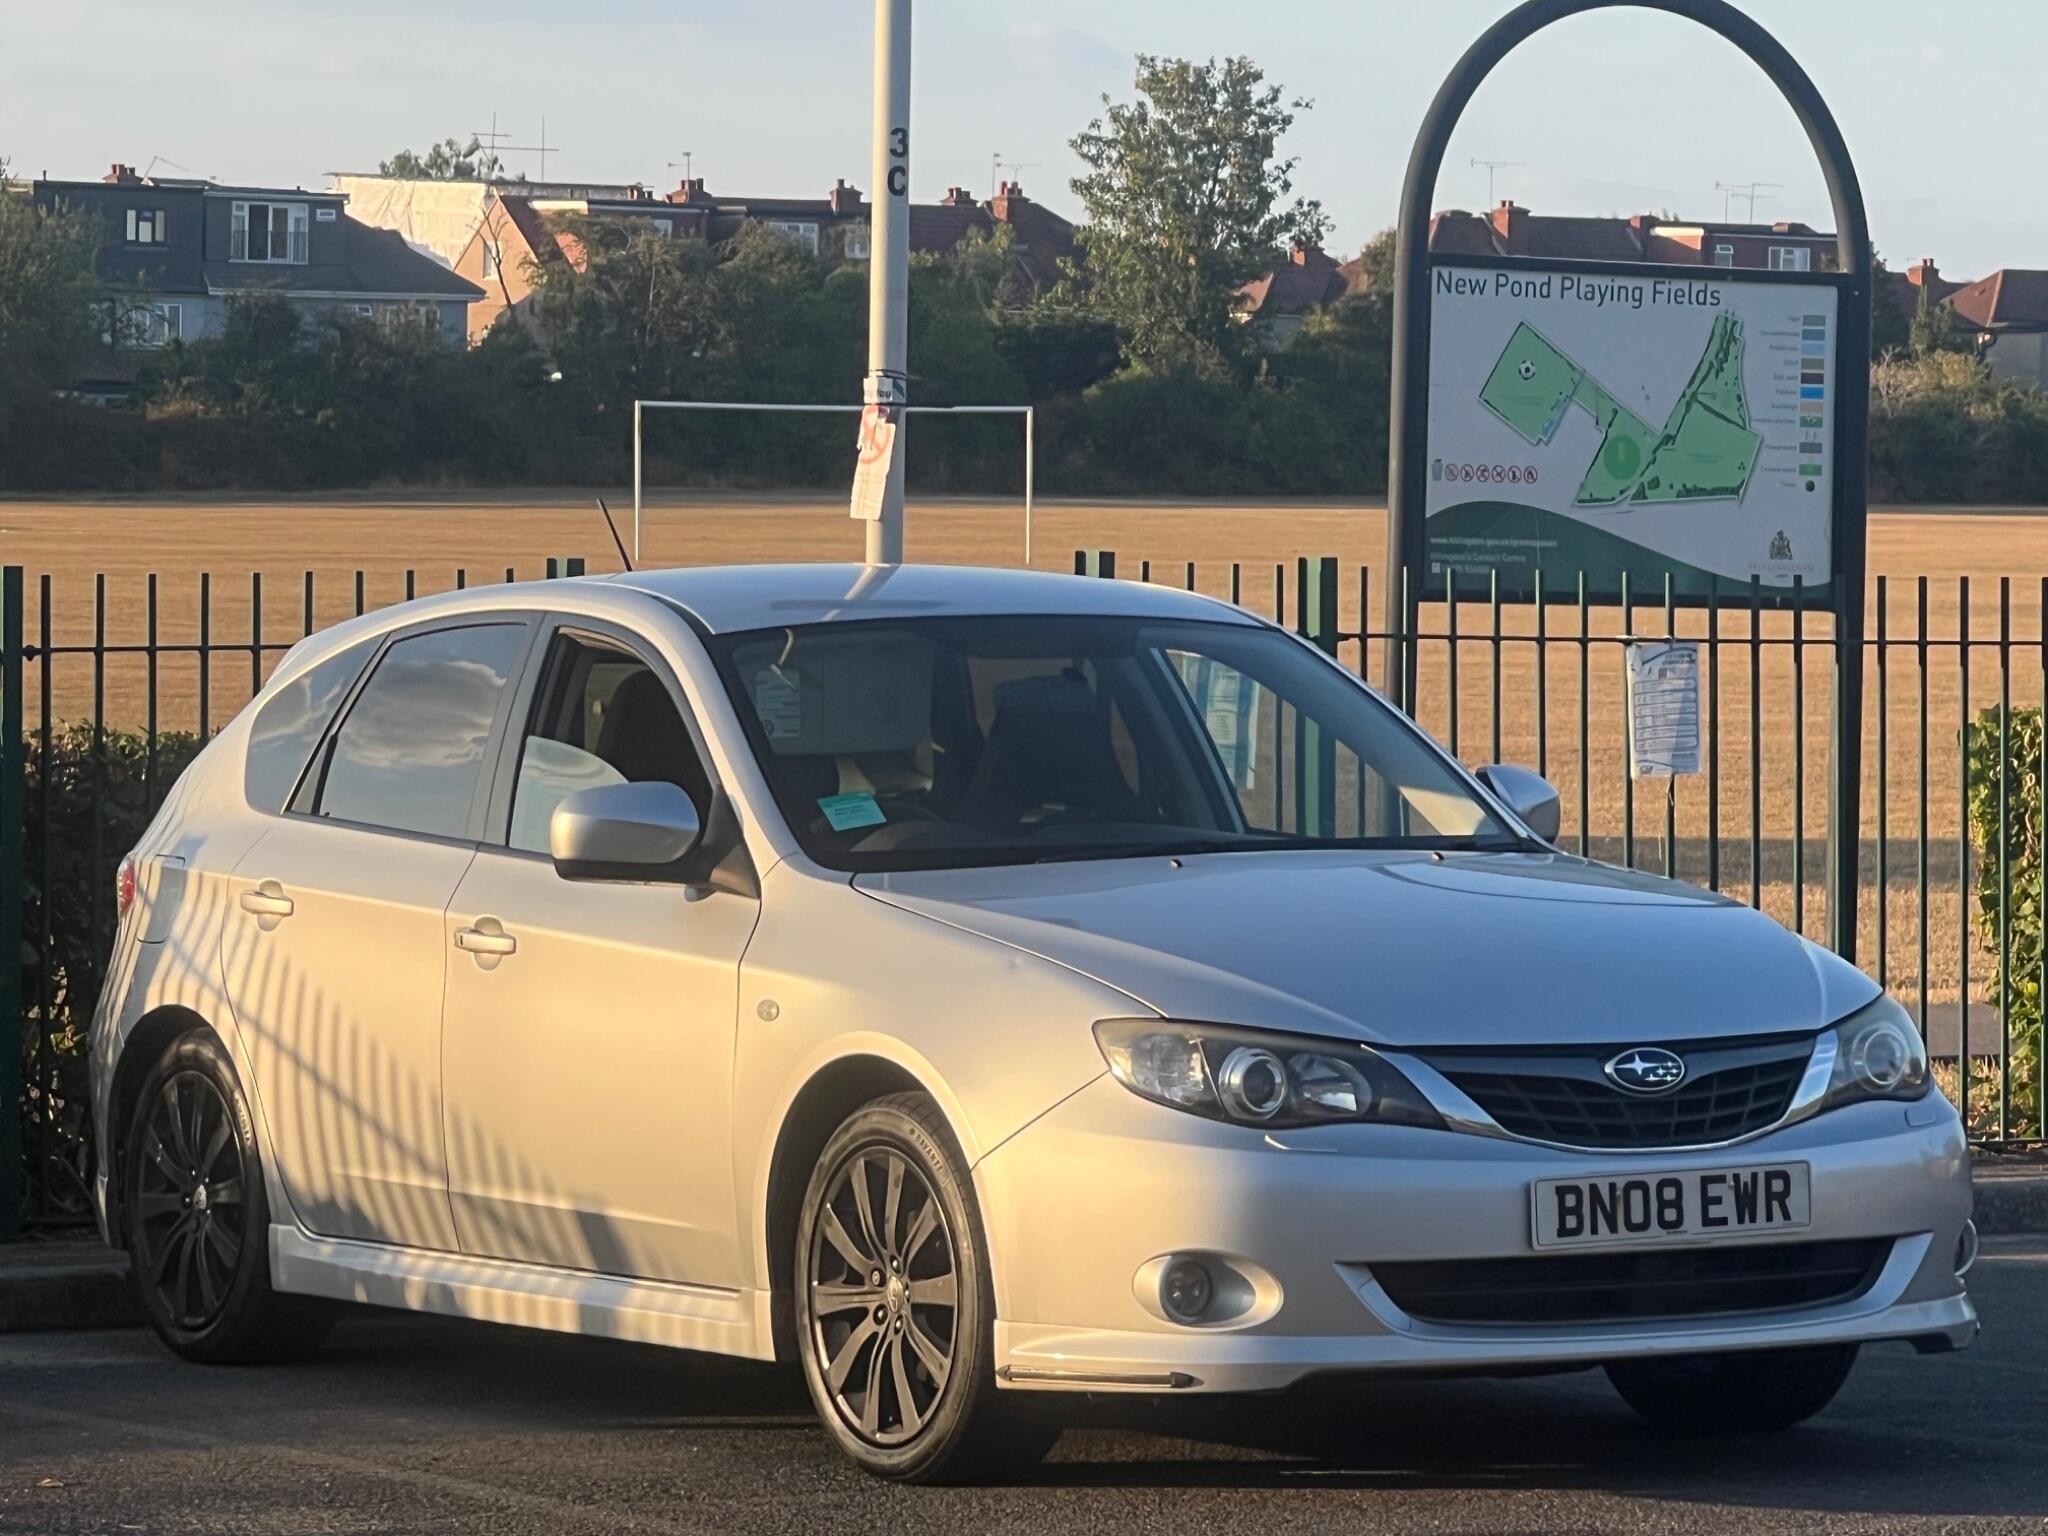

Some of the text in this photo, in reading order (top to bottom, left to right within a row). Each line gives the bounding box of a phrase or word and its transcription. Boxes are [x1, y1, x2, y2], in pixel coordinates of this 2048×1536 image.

[887, 127, 908, 197] 3 C
[1436, 270, 1721, 310] New Pond Playing Fields
[1555, 1169, 1792, 1238] BN08 EWR
